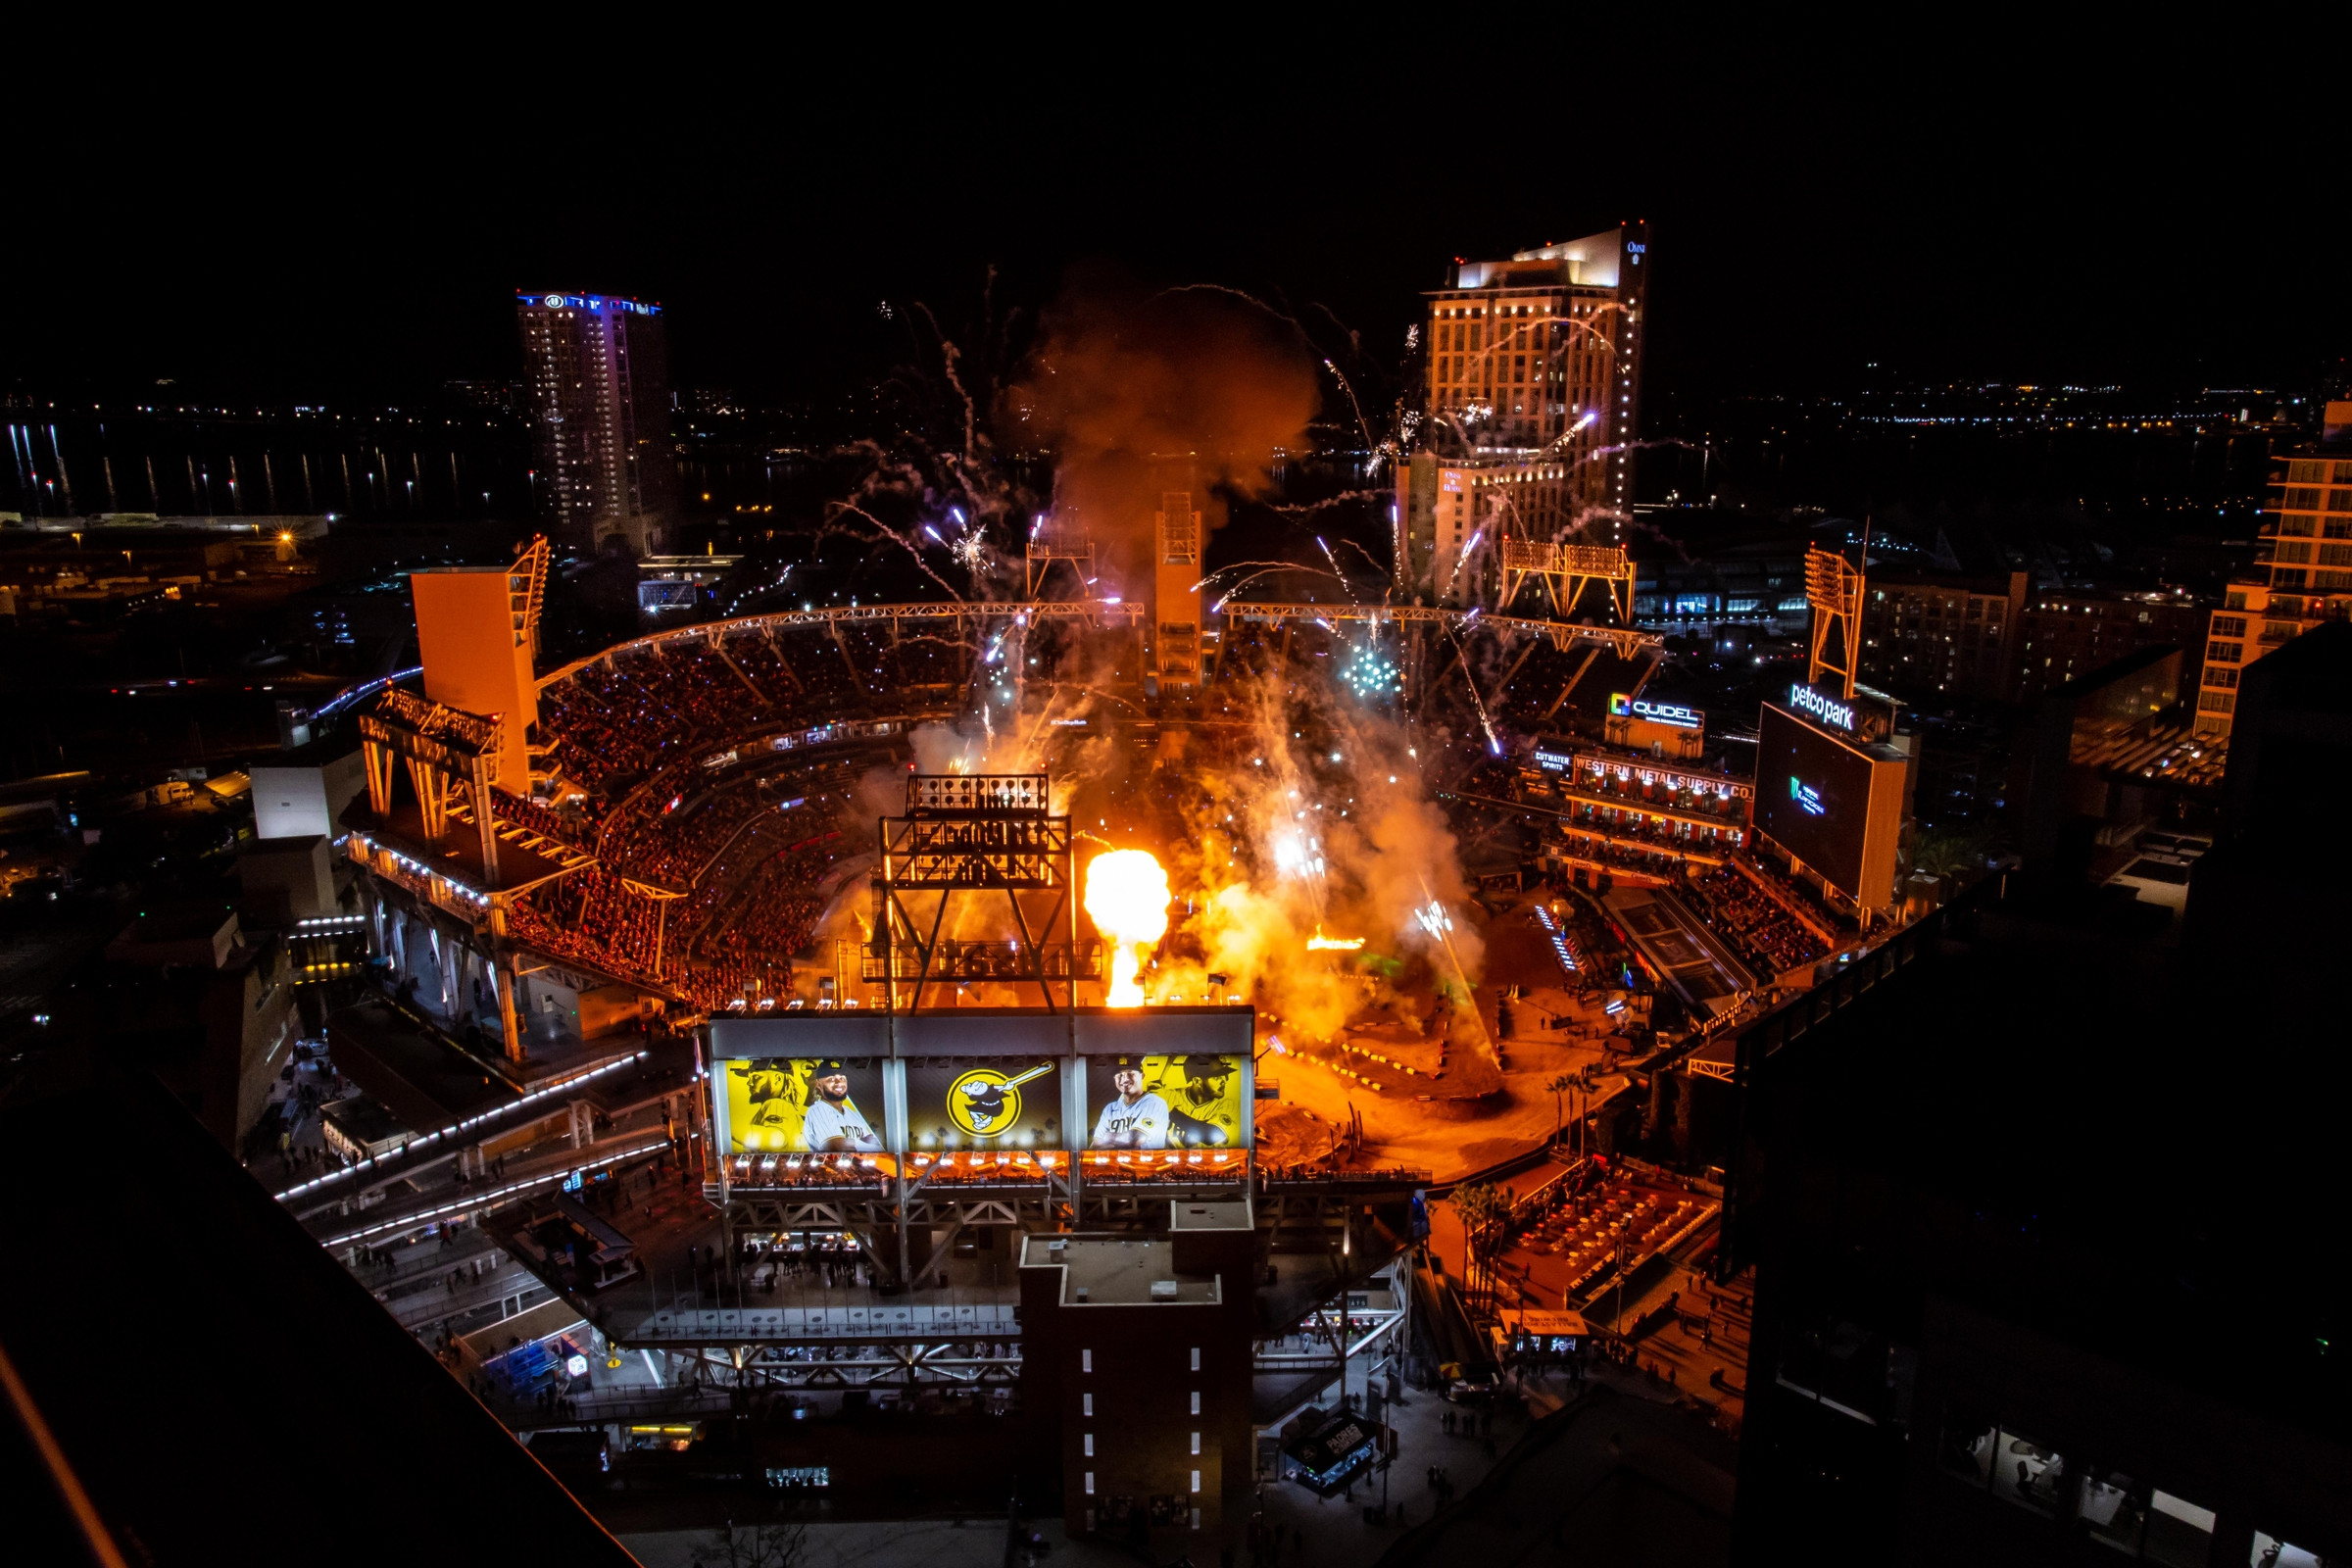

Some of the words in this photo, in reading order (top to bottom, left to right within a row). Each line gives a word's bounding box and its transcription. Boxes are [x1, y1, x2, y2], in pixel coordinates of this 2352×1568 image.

[1633, 702, 1698, 721] QUIDEL
[1790, 684, 1824, 715] petco
[1824, 700, 1854, 731] park
[1536, 752, 1569, 764] CUTWATER
[1542, 761, 1563, 771] SPIRITS
[1576, 758, 1630, 777] WESTERN
[1635, 767, 1673, 785] METAL
[1678, 775, 1727, 795] SUPPLY
[1730, 785, 1752, 801] CO.
